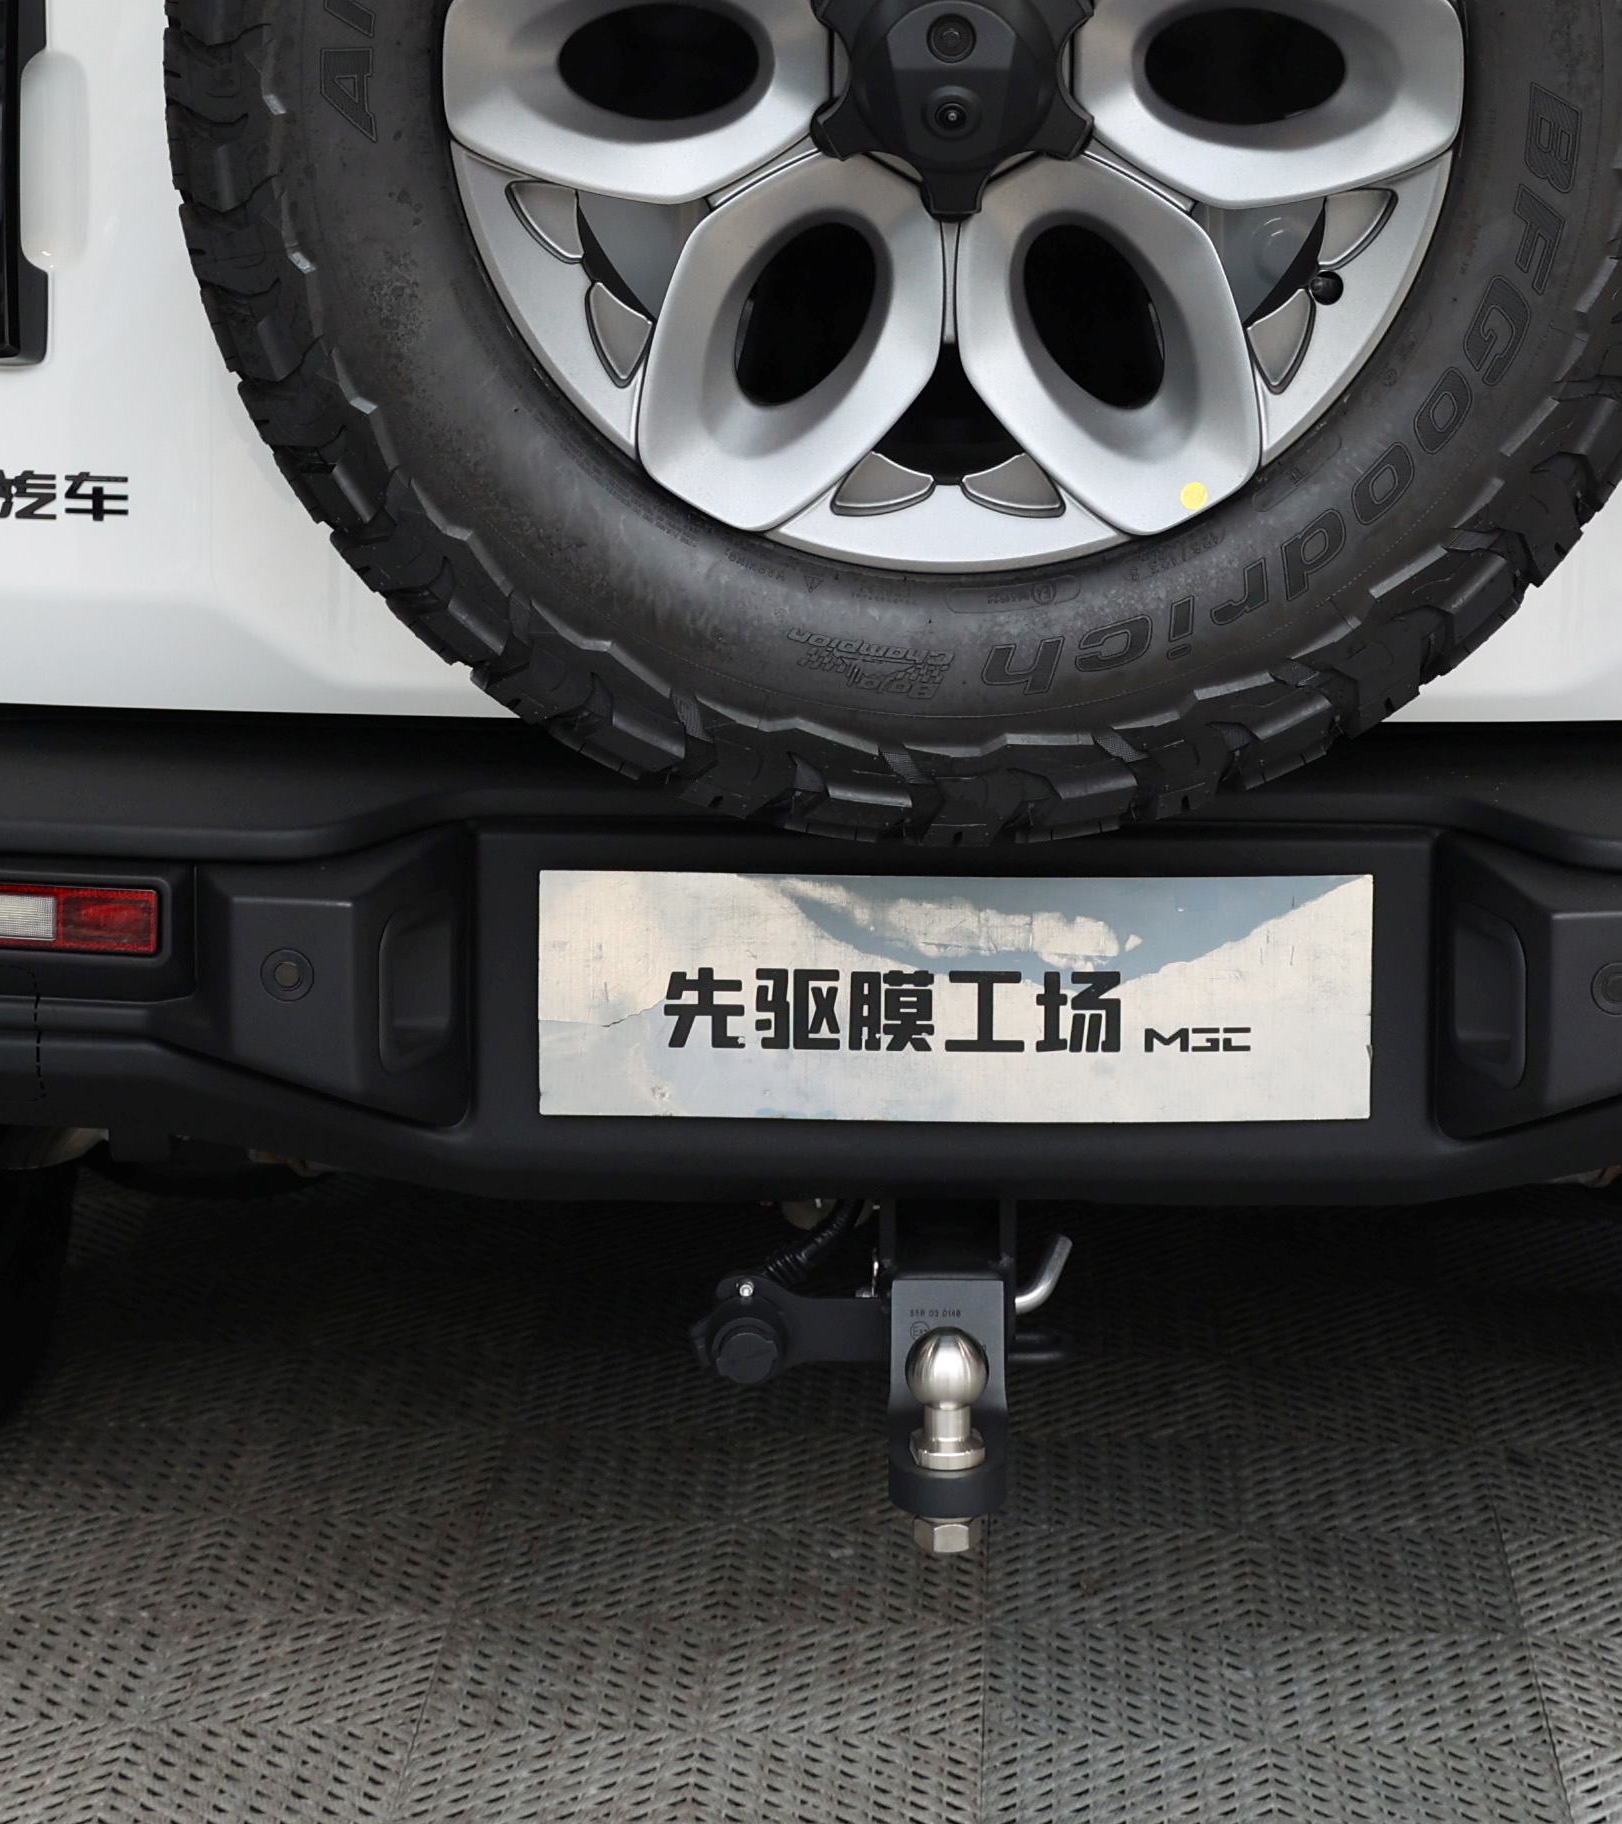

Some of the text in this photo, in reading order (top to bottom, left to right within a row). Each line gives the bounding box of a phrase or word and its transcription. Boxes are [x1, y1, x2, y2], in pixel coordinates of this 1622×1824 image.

[663, 966, 1122, 1054] 先驱膜工场
